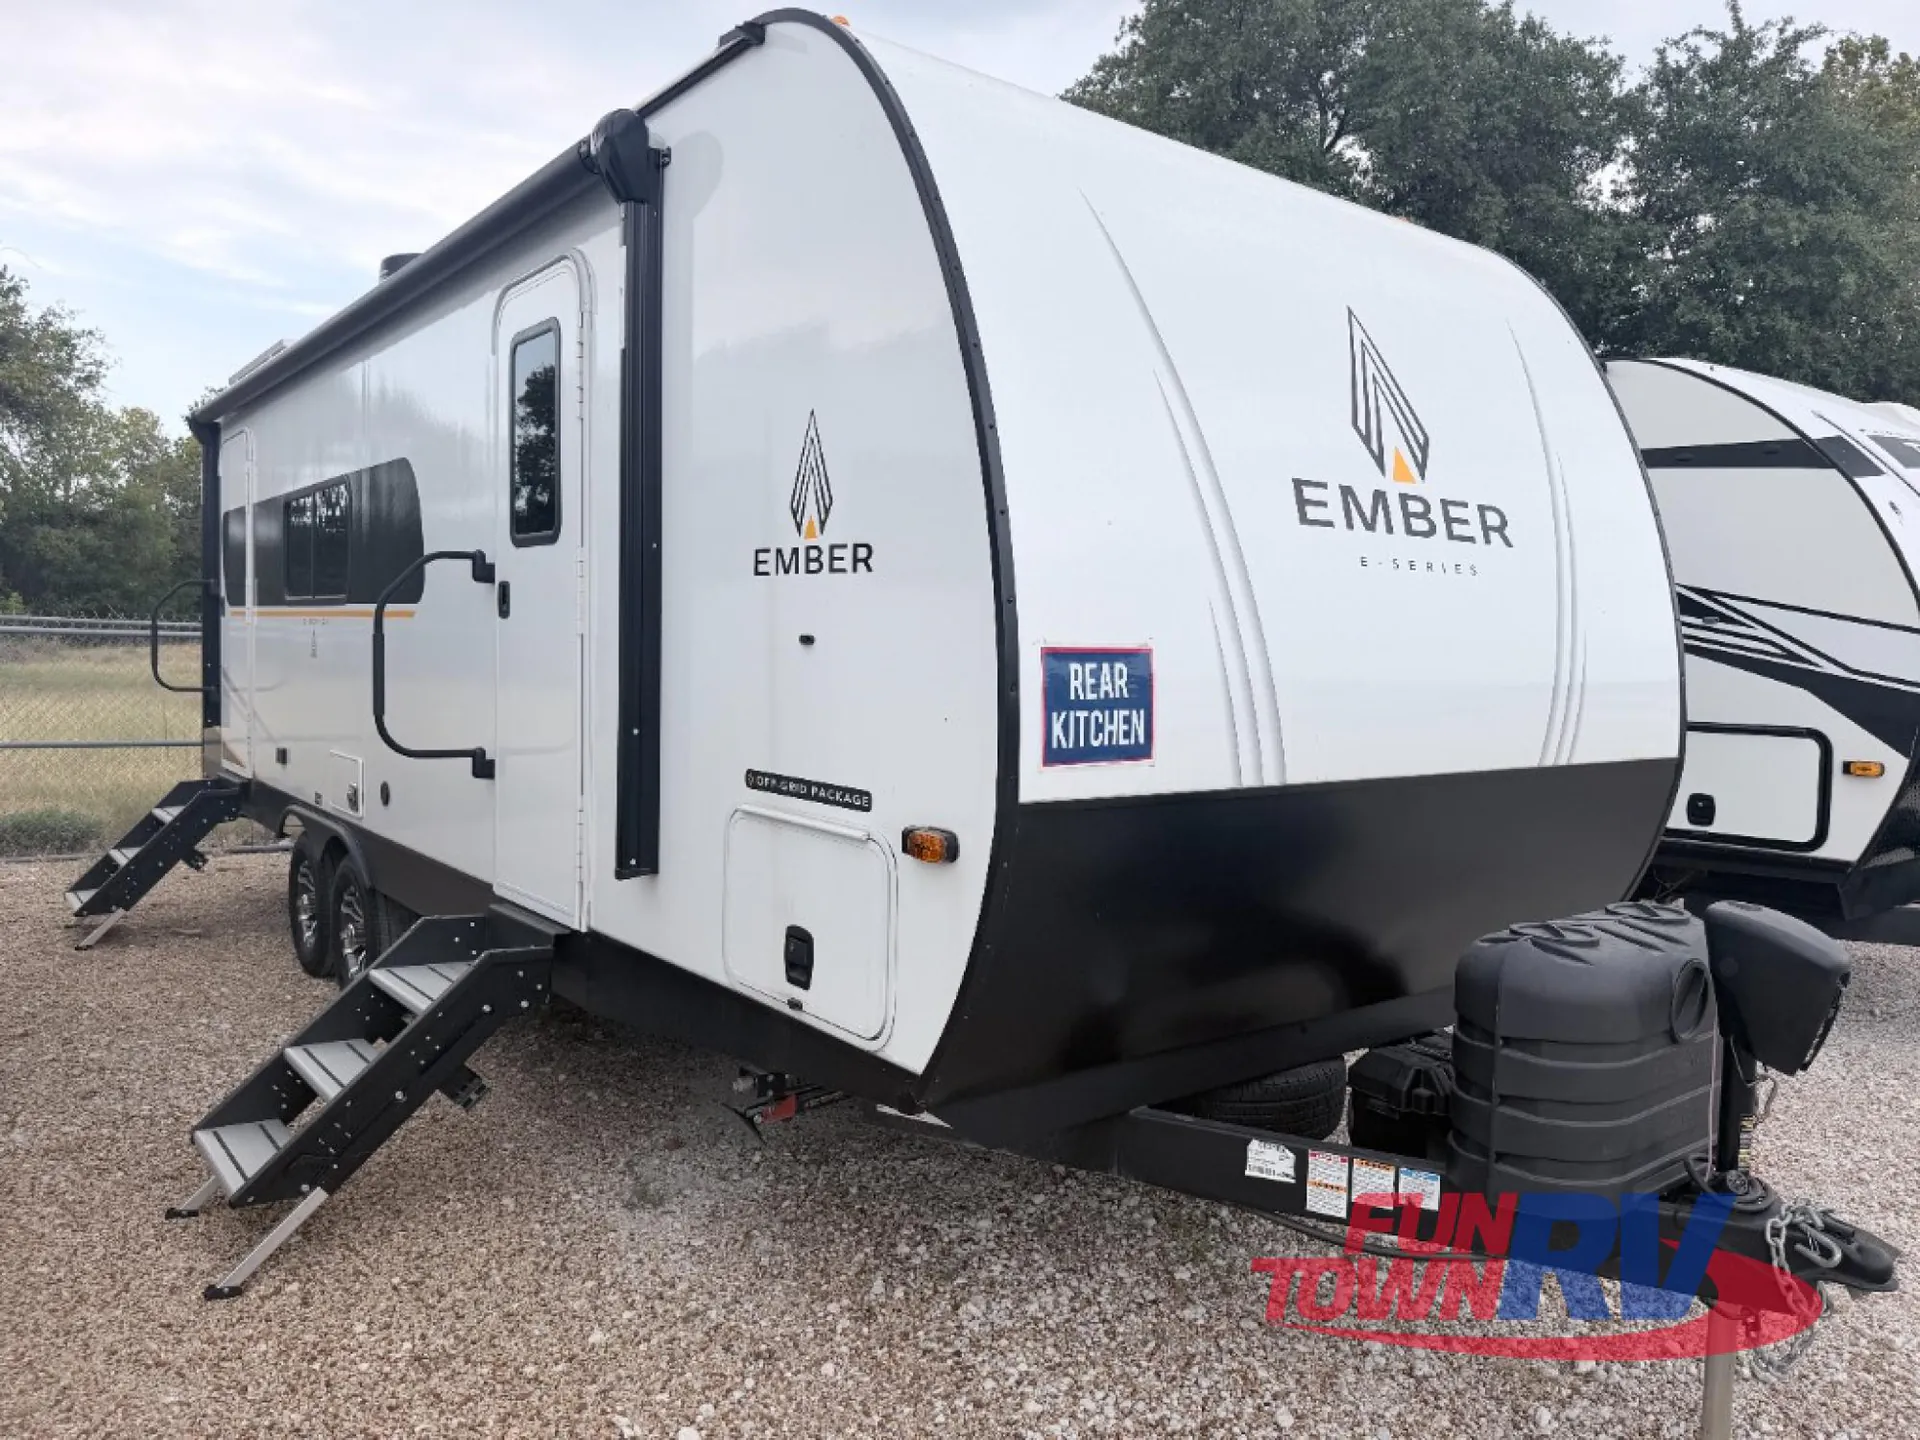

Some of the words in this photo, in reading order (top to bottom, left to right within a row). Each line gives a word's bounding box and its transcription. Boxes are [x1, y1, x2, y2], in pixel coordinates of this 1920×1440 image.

[1291, 477, 1514, 548] EMBER
[753, 543, 873, 576] EMBER
[1360, 556, 1479, 577] E-SERIES
[1069, 661, 1129, 700] REAR
[1051, 708, 1145, 749] KITCHEN
[811, 785, 869, 807] PACKAGE
